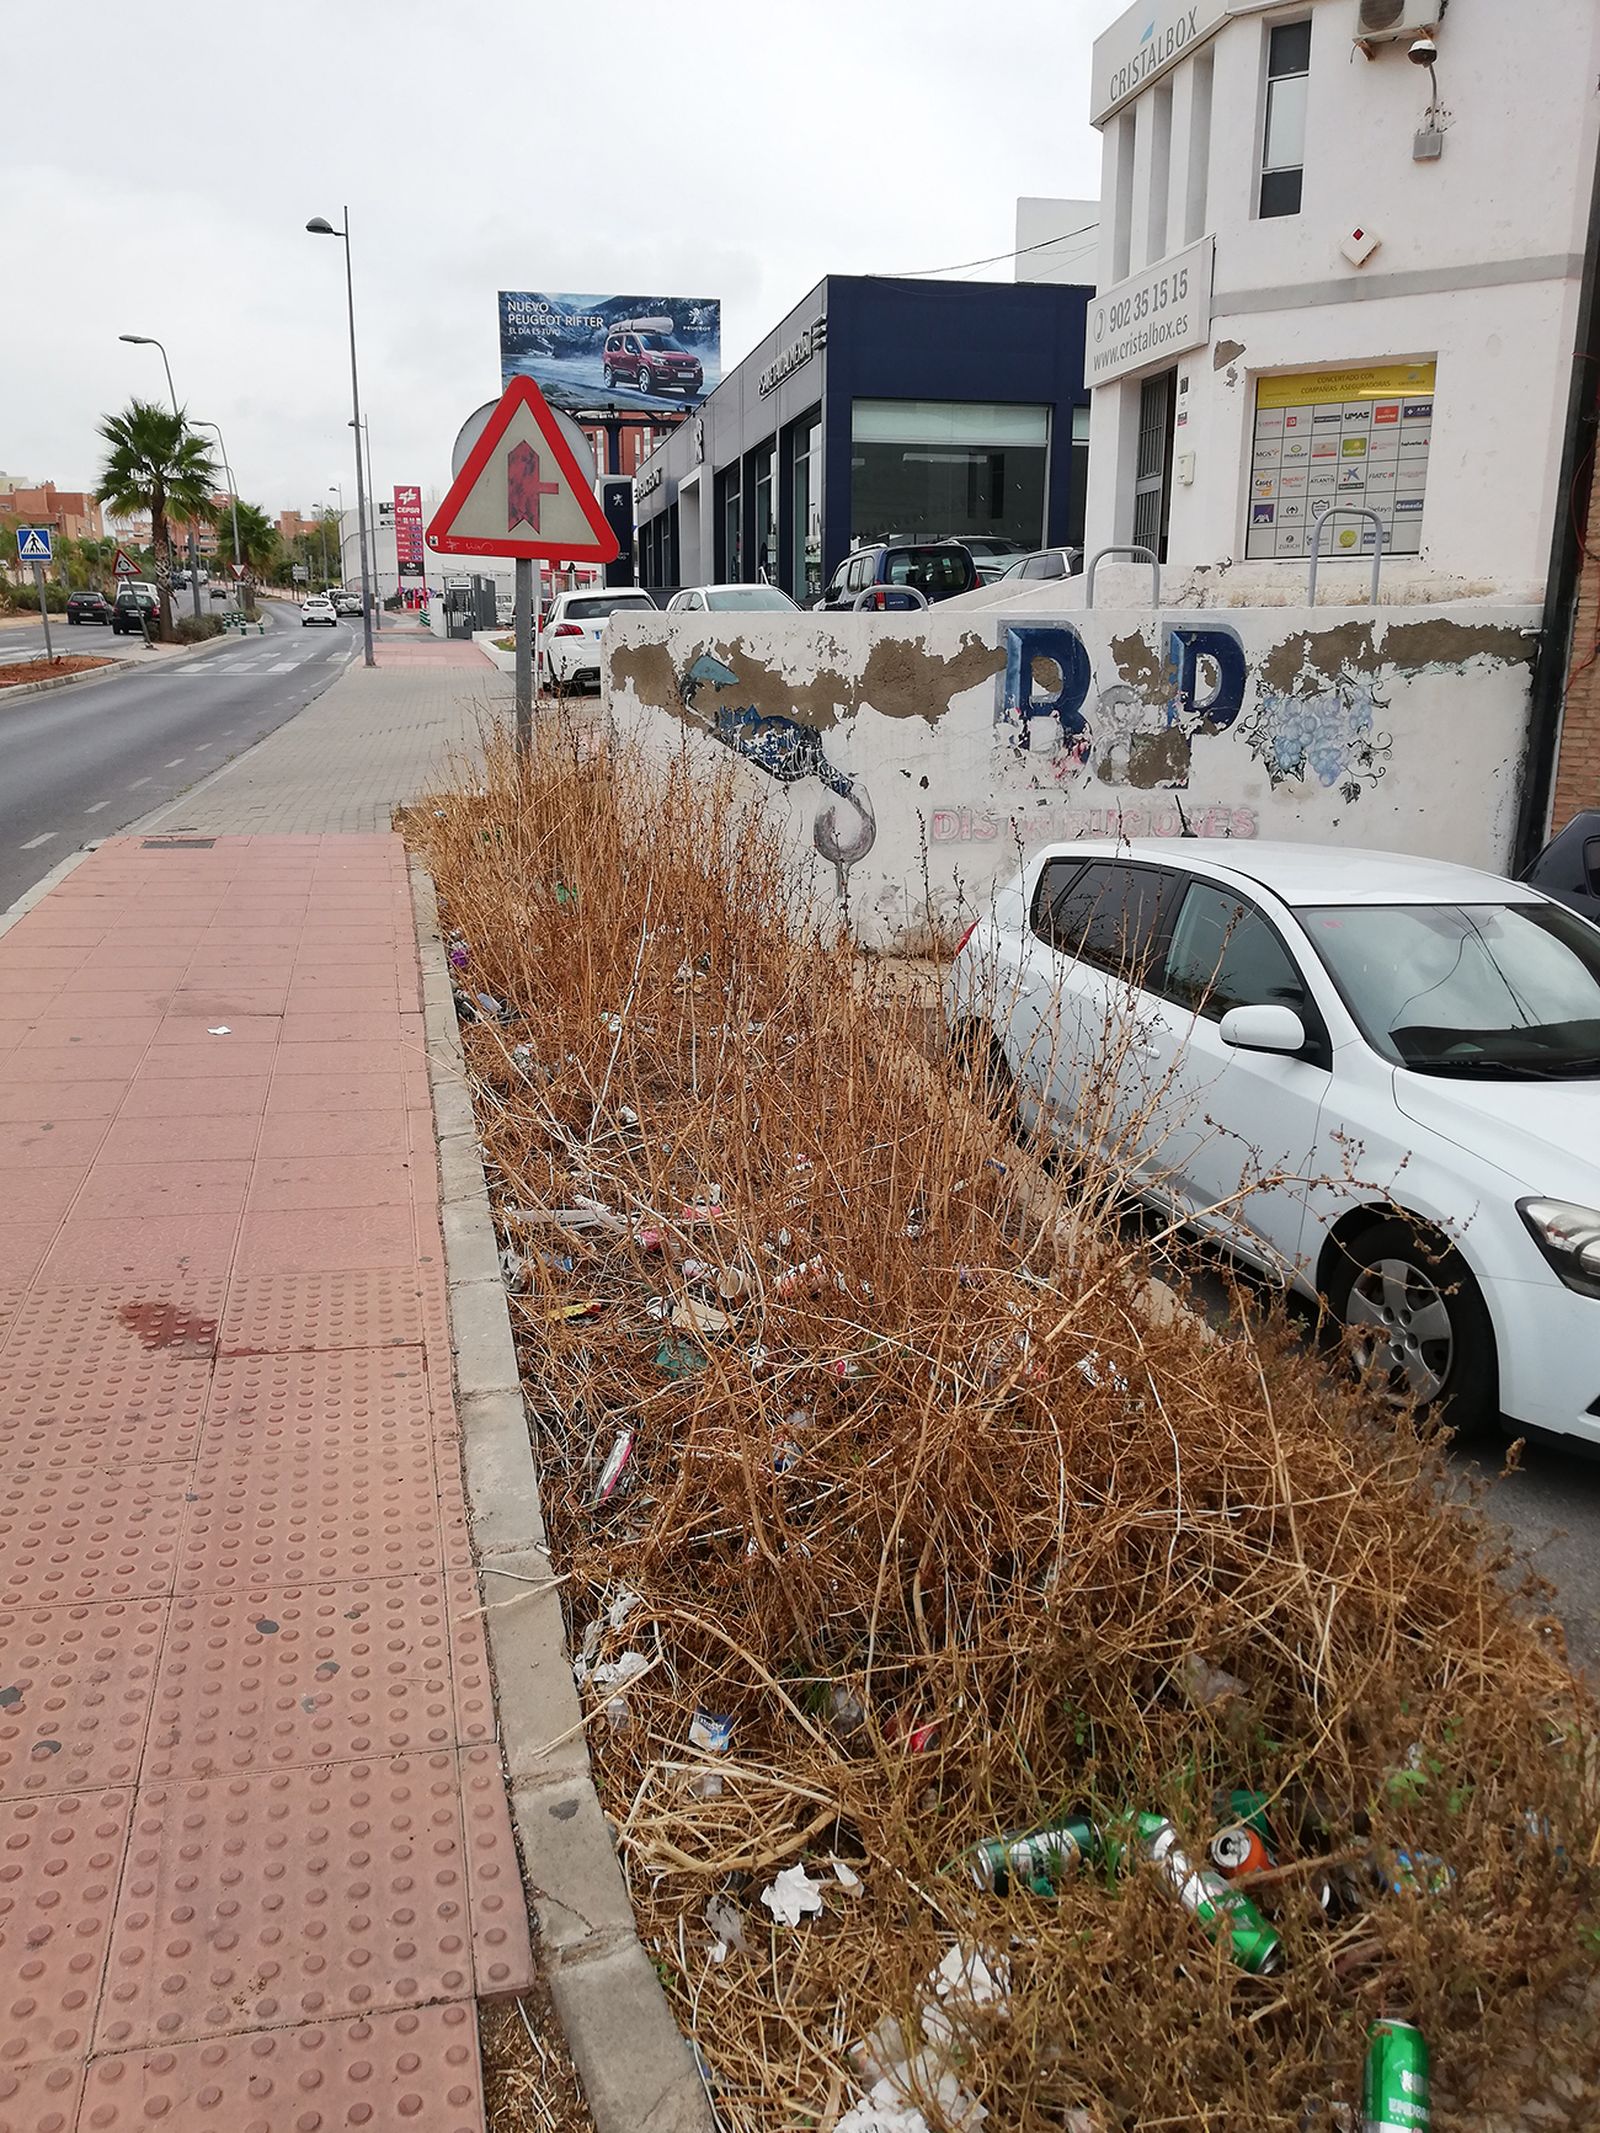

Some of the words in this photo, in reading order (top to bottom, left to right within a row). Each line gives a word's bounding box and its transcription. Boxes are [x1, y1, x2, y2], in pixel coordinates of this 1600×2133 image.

[1110, 6, 1198, 101] CRISTALBOX
[1110, 298, 1131, 332] 902
[1133, 289, 1149, 321] 35
[1152, 279, 1168, 312] 15
[1172, 268, 1188, 304] 15
[507, 301, 549, 313] NUEVO
[508, 314, 562, 326] PEUGEOT
[565, 316, 604, 328] RIFTER
[1094, 314, 1188, 371] www.cristalbox.es
[1317, 373, 1359, 384] CONCERTADO
[1360, 371, 1374, 380] CON
[1339, 380, 1391, 391] ASEGURADORAS
[397, 506, 420, 514] CEPSA
